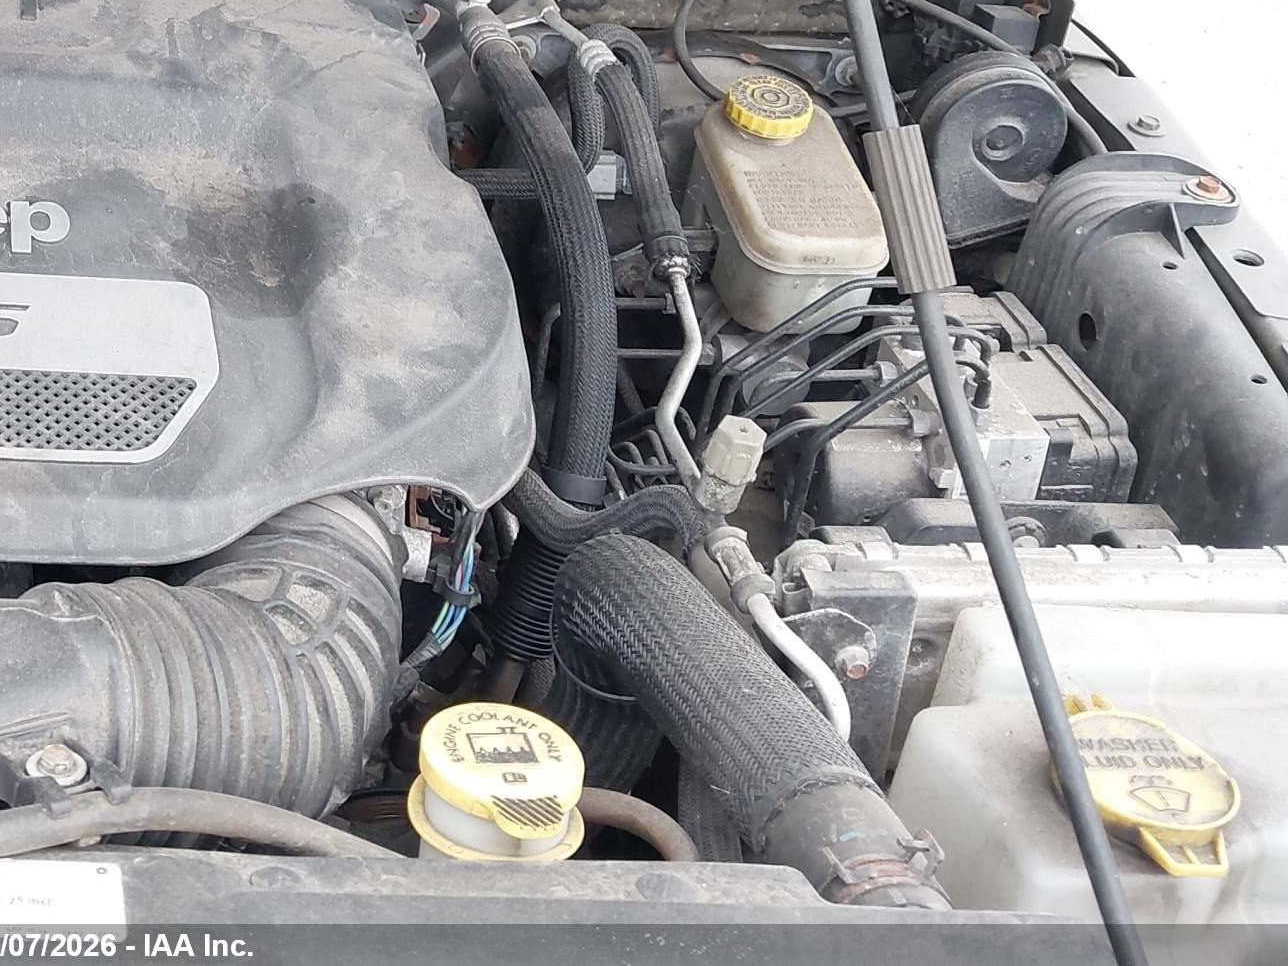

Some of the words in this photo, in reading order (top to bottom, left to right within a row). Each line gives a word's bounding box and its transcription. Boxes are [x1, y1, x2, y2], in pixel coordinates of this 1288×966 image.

[443, 723, 465, 763] ENGINE
[458, 712, 539, 730] COOLANT
[538, 732, 563, 762] ONLY
[1084, 755, 1137, 769] LUID
[1143, 755, 1205, 770] ONLY
